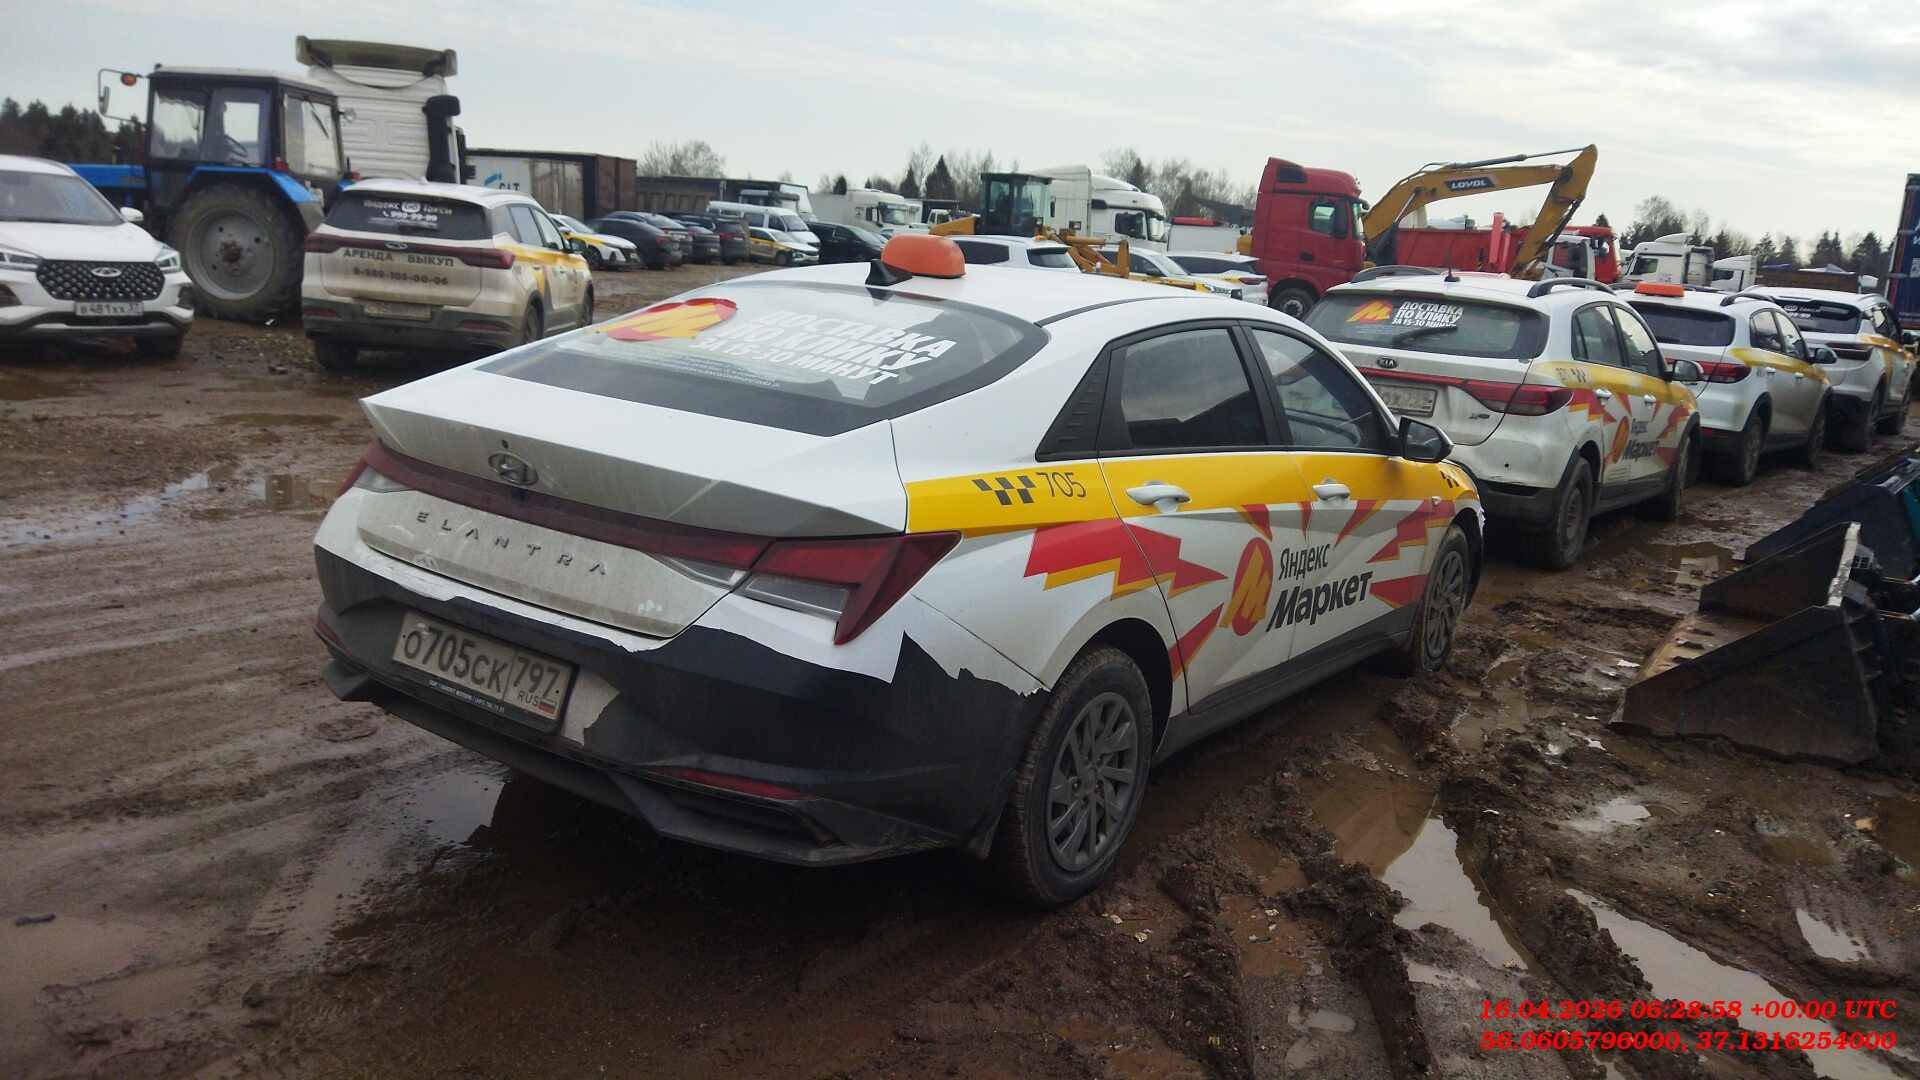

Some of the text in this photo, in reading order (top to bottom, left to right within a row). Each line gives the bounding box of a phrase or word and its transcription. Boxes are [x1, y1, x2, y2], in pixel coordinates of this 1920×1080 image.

[1451, 179, 1488, 189] LOVOL
[343, 249, 454, 267] АРЕНДА ВЫКУП
[1395, 308, 1461, 324] ПО КЛИКУ
[1400, 301, 1464, 316] ДОСТАВКА
[715, 320, 784, 344] ПО
[776, 332, 934, 371] КЛИКУ
[758, 309, 957, 358] ДОСТАВКА
[787, 353, 900, 385] МИНУТ
[1035, 471, 1087, 498] 705
[417, 511, 607, 576] ELANTRA
[1278, 543, 1331, 580] Яндекс
[1266, 571, 1374, 632] Маркет
[513, 656, 561, 699] 797
[516, 690, 540, 708] RUS
